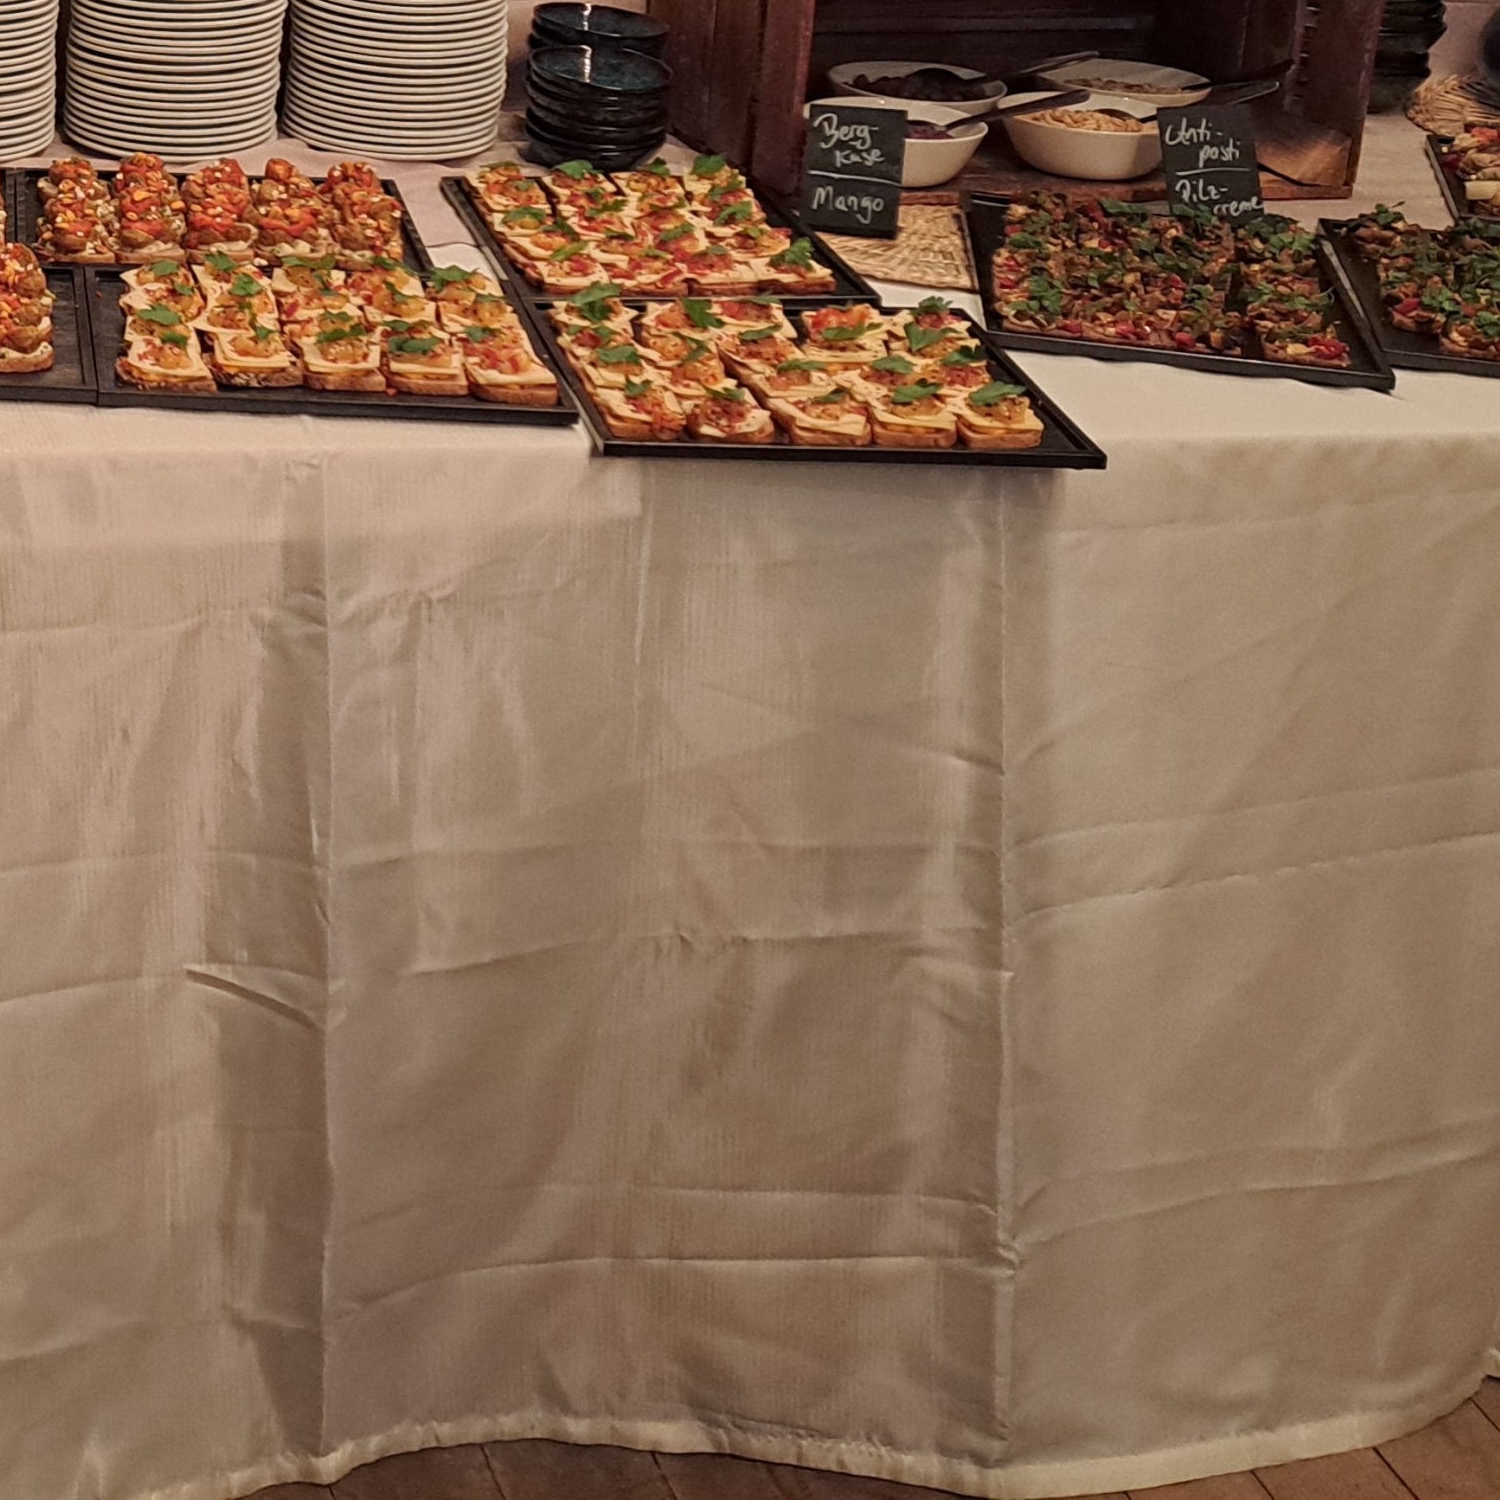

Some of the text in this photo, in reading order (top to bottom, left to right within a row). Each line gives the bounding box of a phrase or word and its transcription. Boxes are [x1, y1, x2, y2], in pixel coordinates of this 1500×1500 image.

[812, 113, 880, 150] Berg-
[812, 185, 884, 224] Mango
[1175, 179, 1229, 203] Pilz-
